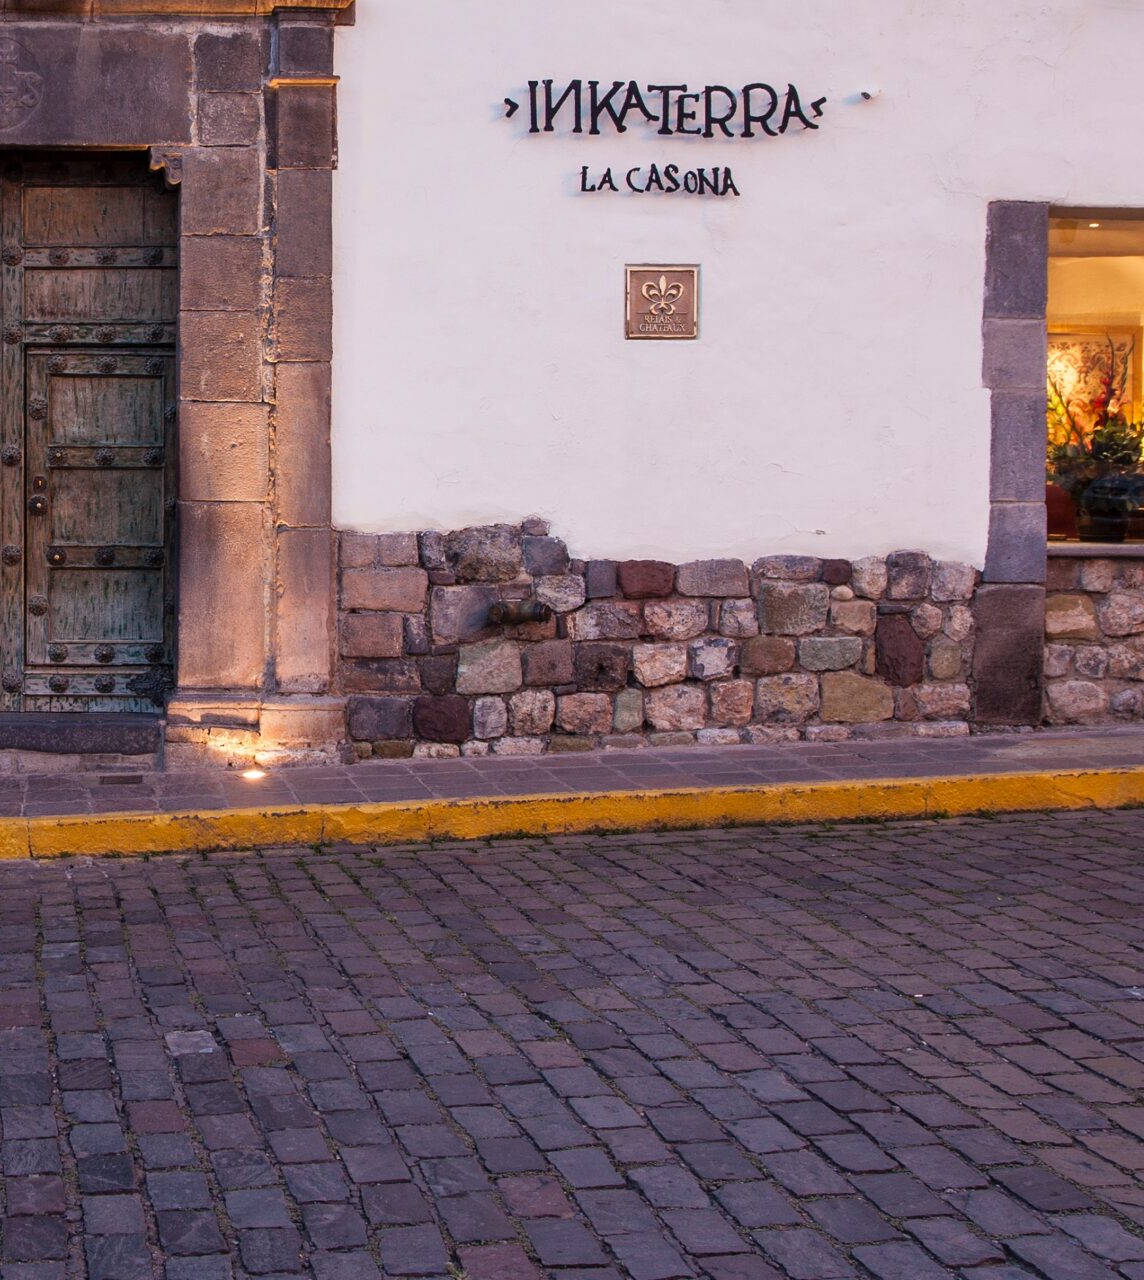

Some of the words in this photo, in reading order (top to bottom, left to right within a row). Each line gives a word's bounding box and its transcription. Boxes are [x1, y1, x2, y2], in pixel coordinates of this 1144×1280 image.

[528, 79, 819, 138] INKATERRA
[580, 165, 619, 193] LA
[625, 163, 741, 197] CASONA
[644, 315, 672, 324] RELAIS
